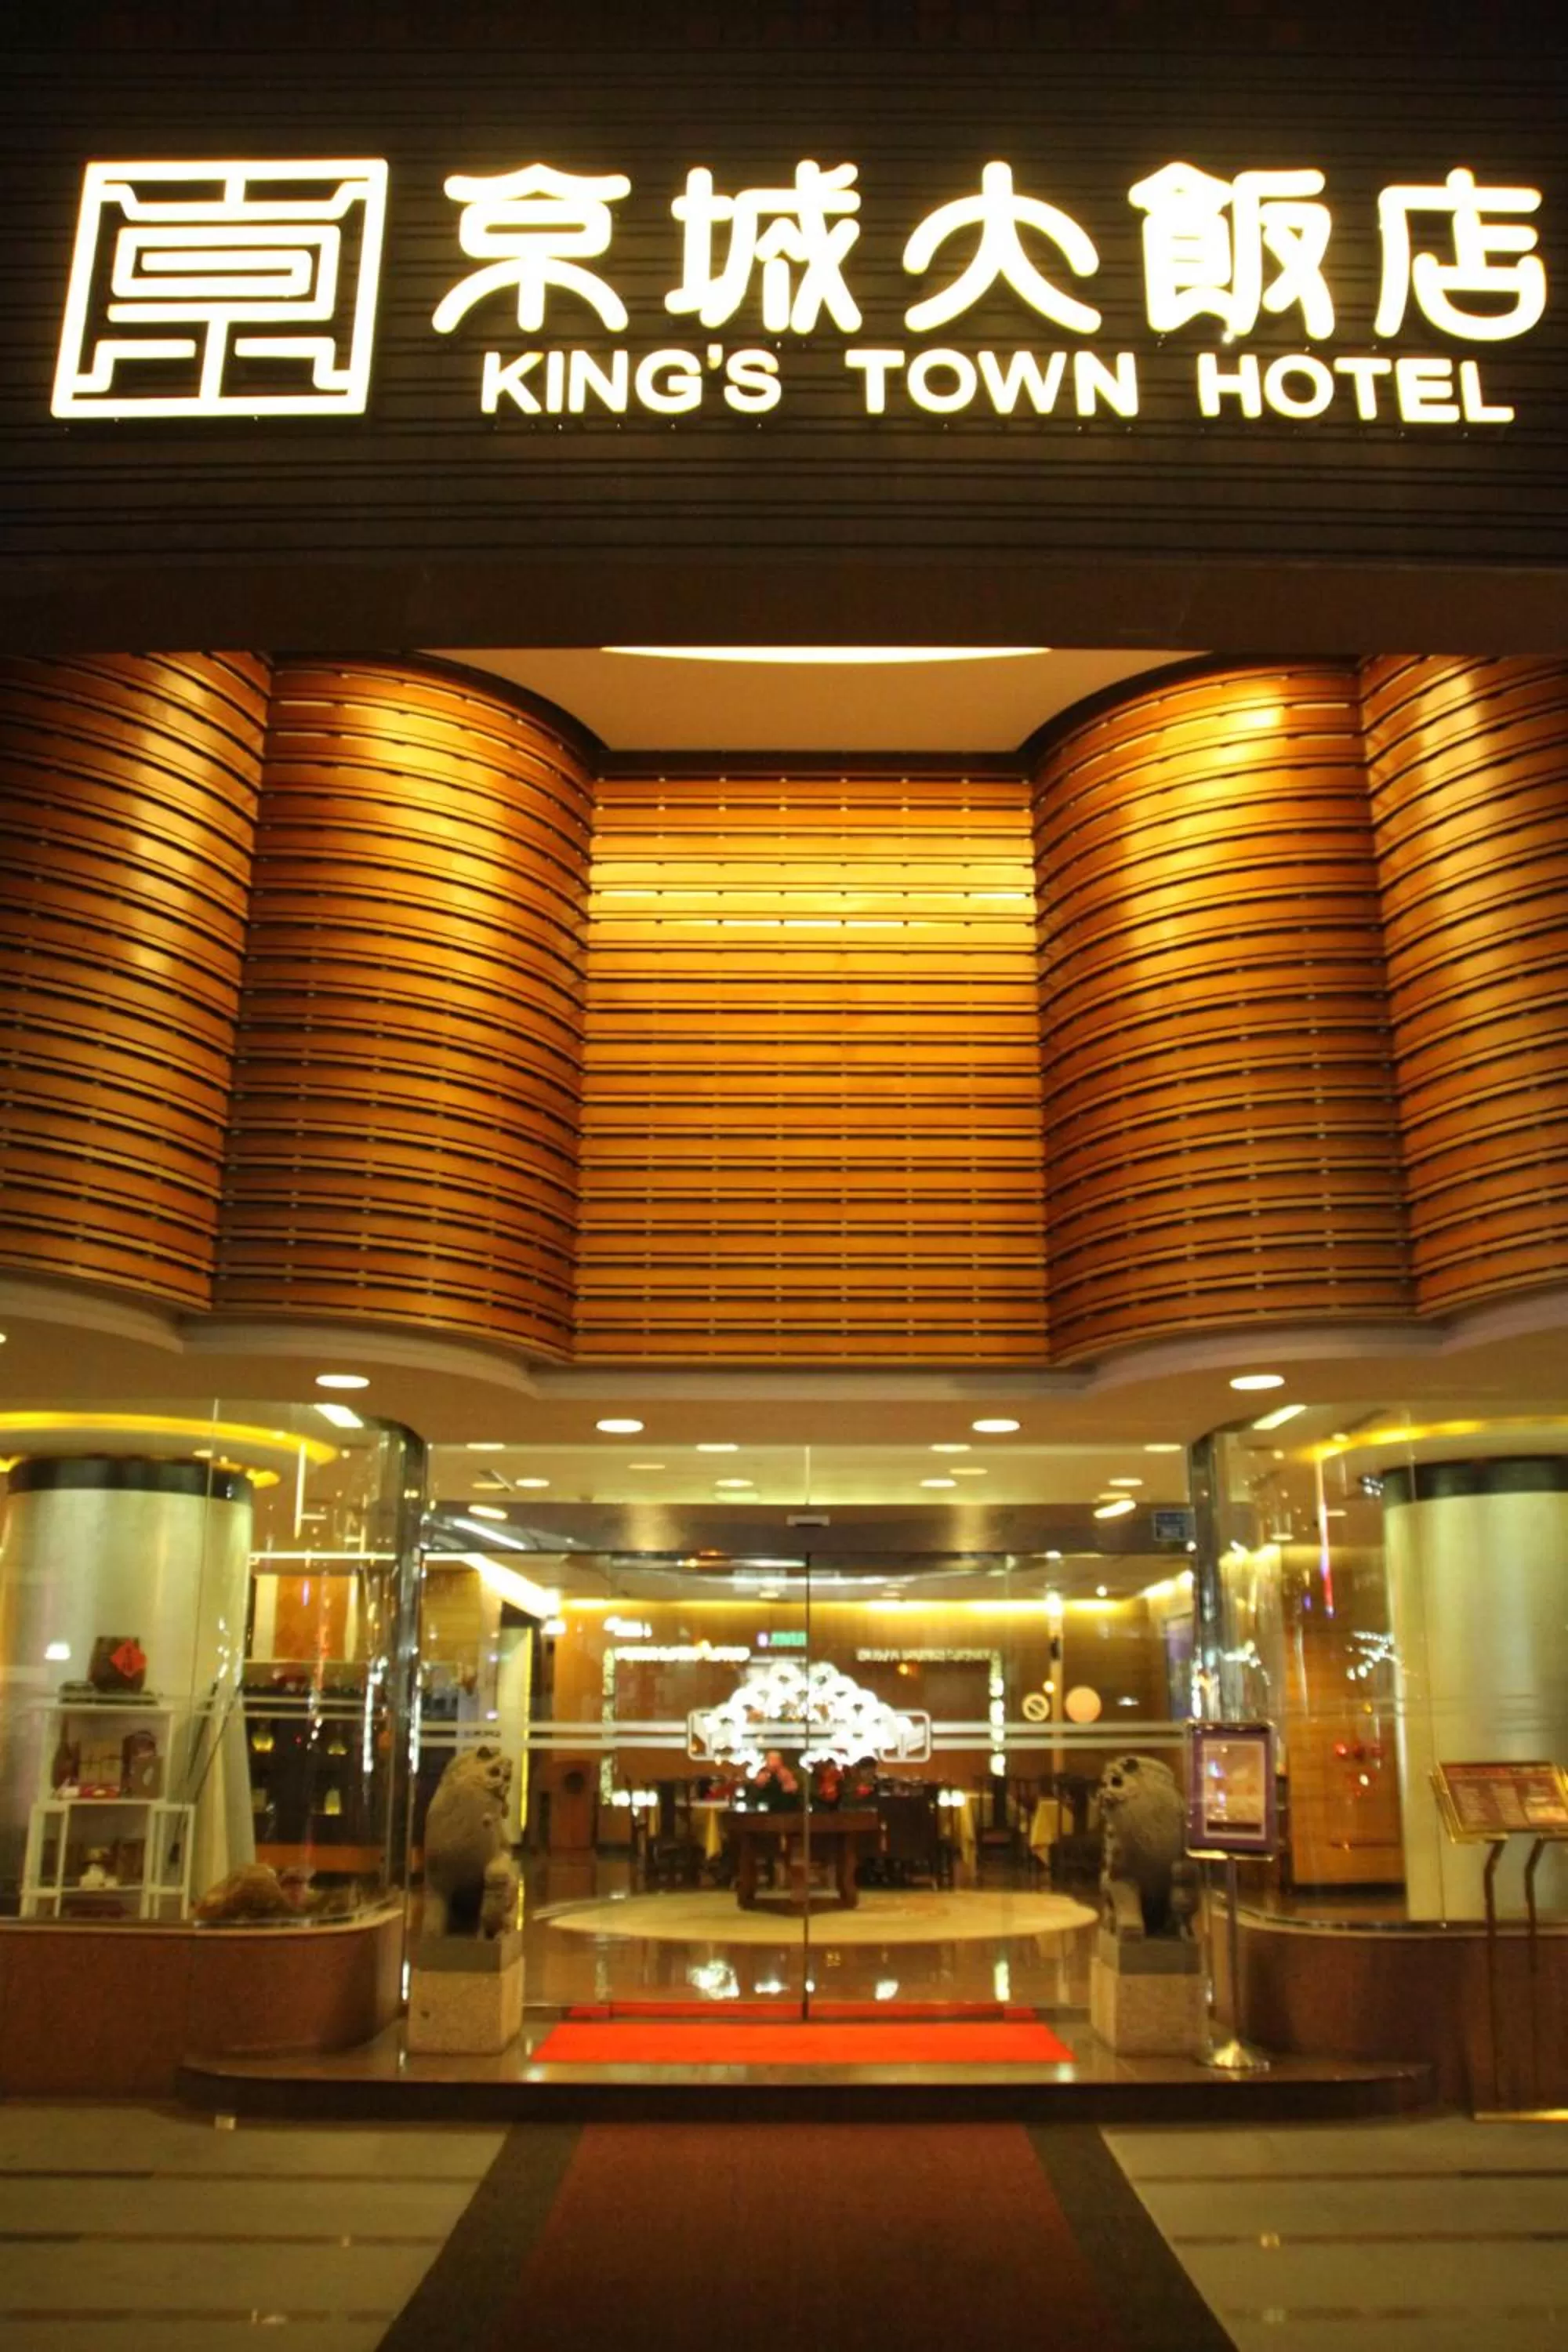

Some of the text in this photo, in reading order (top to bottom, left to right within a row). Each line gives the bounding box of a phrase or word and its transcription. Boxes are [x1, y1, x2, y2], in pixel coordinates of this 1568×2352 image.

[433, 161, 1544, 340] 京城大飯店
[481, 343, 1514, 422] KING'S TOWN HOTEL
